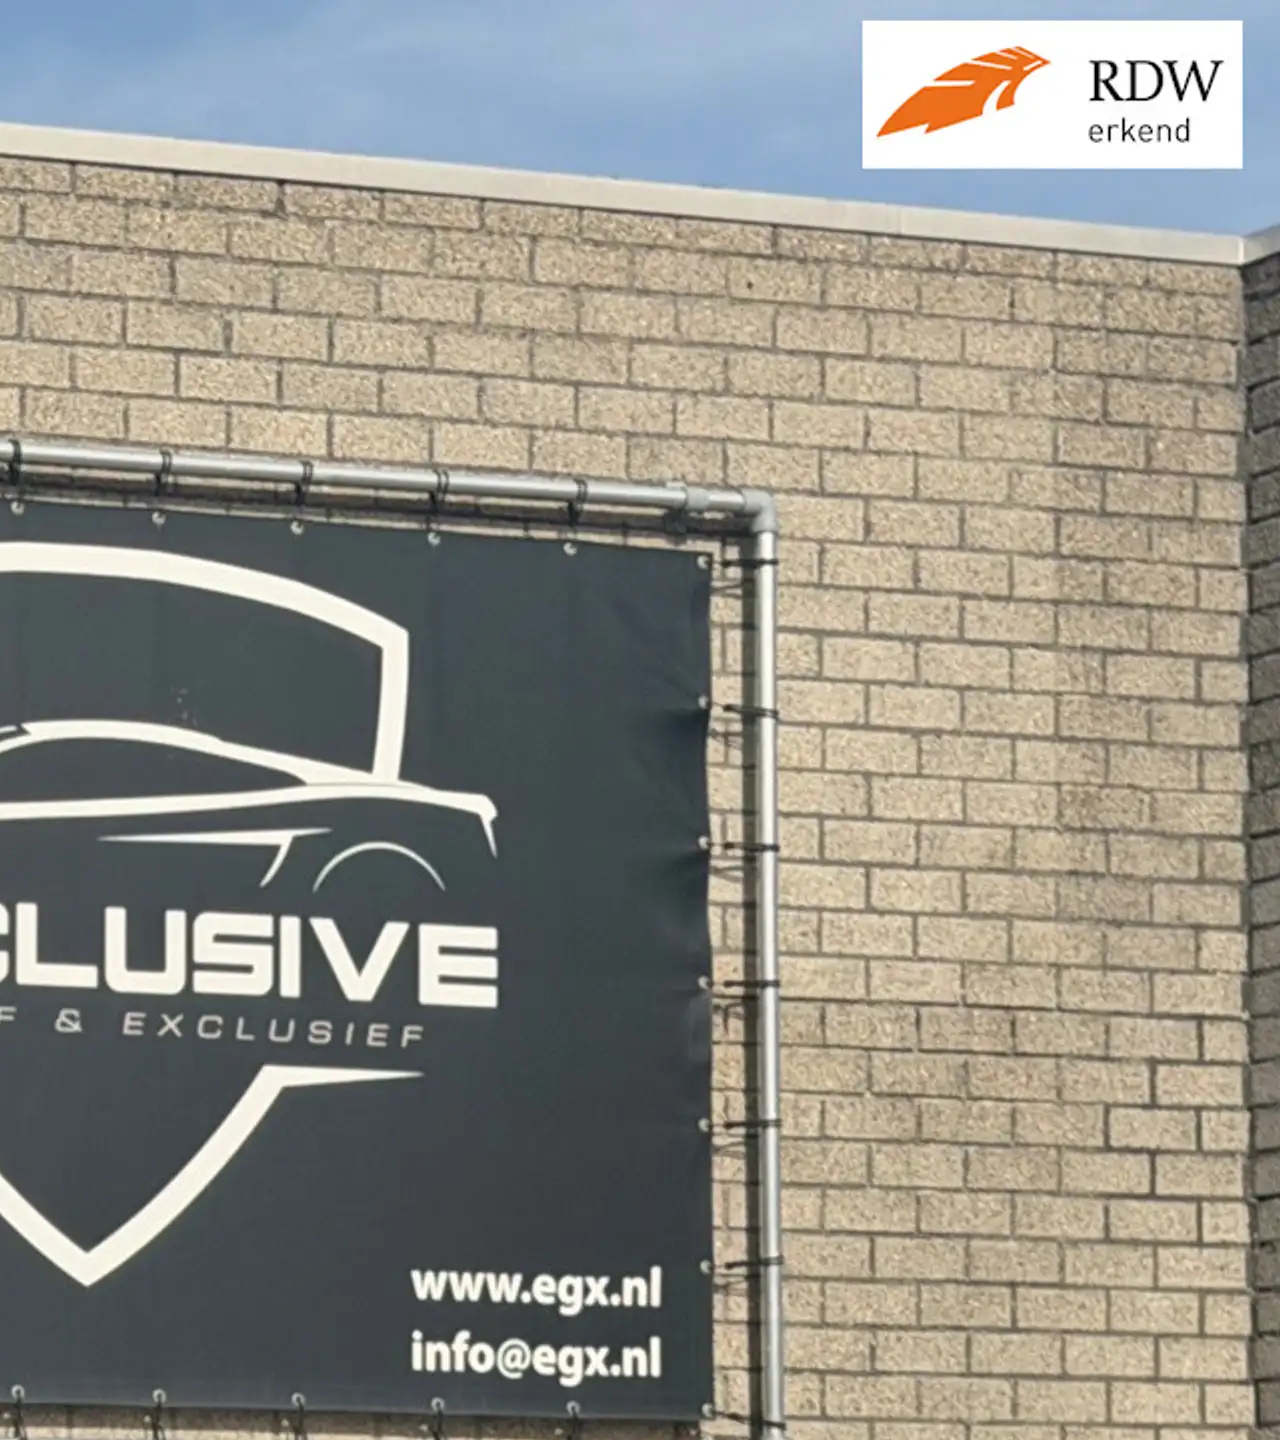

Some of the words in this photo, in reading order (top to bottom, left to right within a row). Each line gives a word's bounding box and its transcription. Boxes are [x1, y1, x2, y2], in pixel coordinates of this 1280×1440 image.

[55, 1008, 82, 1032] &
[123, 1012, 423, 1047] EXCLUSIEF
[411, 1266, 661, 1316] www.egx.nl
[412, 1330, 661, 1387] info@egx.nl
